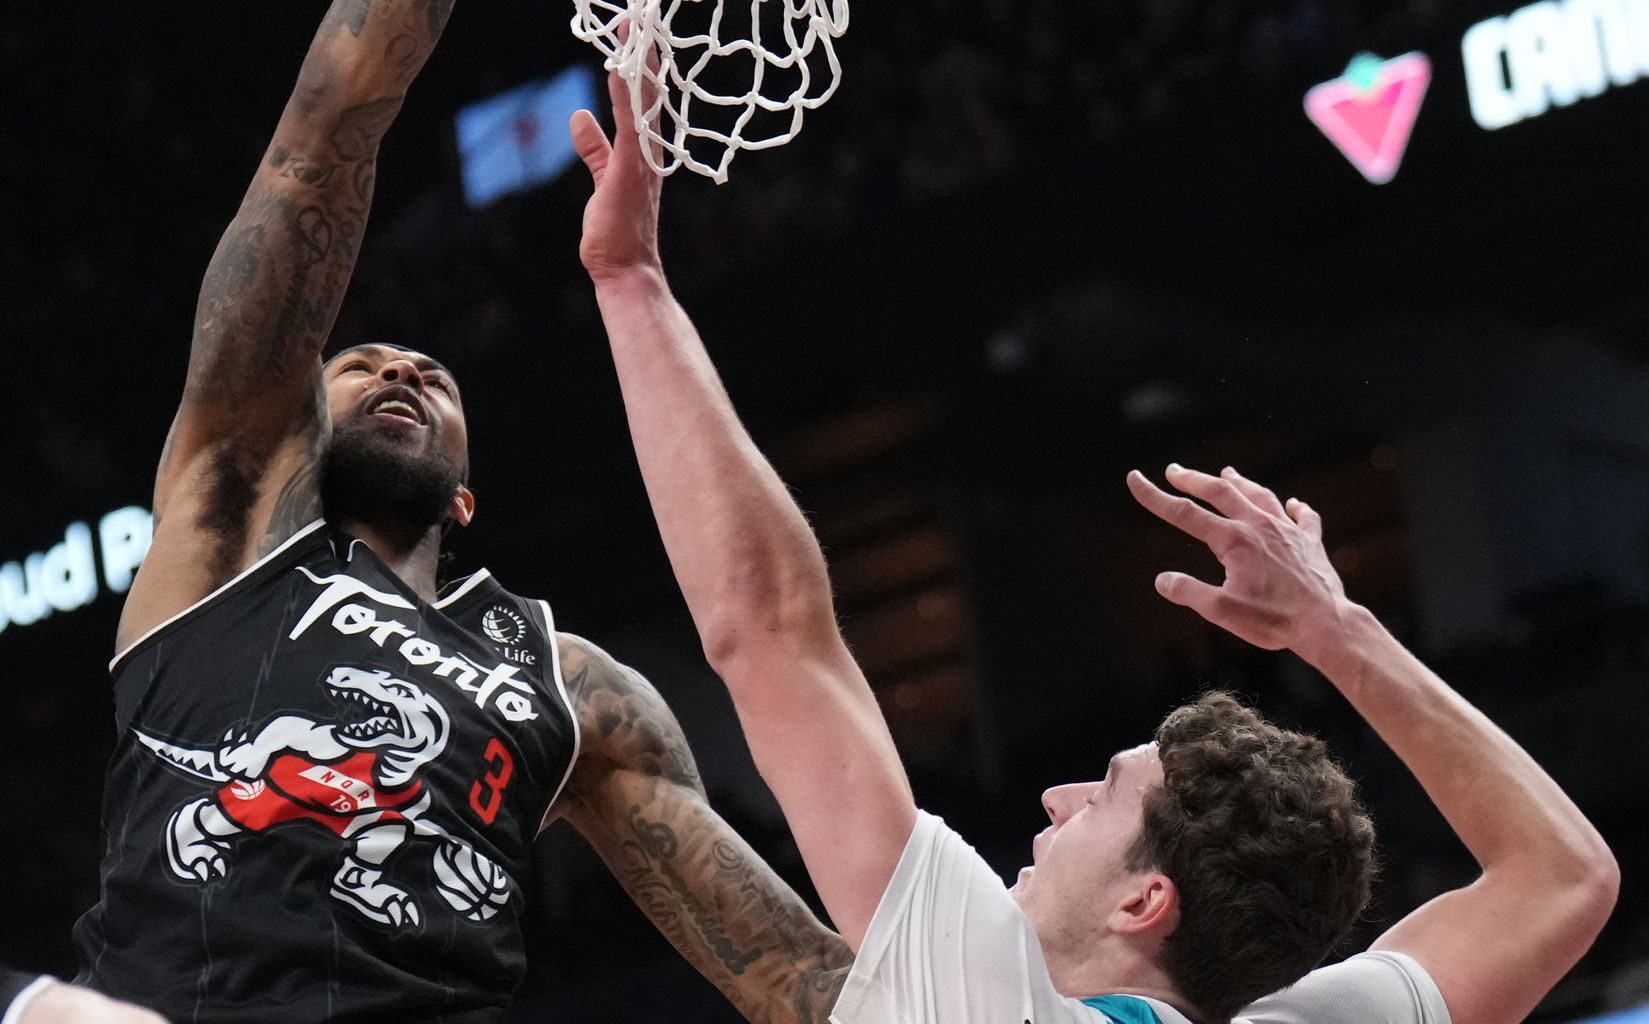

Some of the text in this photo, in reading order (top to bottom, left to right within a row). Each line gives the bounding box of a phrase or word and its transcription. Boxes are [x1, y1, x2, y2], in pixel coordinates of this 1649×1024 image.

[0, 521, 98, 632] ud
[289, 566, 539, 721] Toronto
[504, 647, 536, 665] Life
[321, 771, 369, 801] NOR
[330, 795, 351, 813] 19
[469, 736, 514, 825] 3
